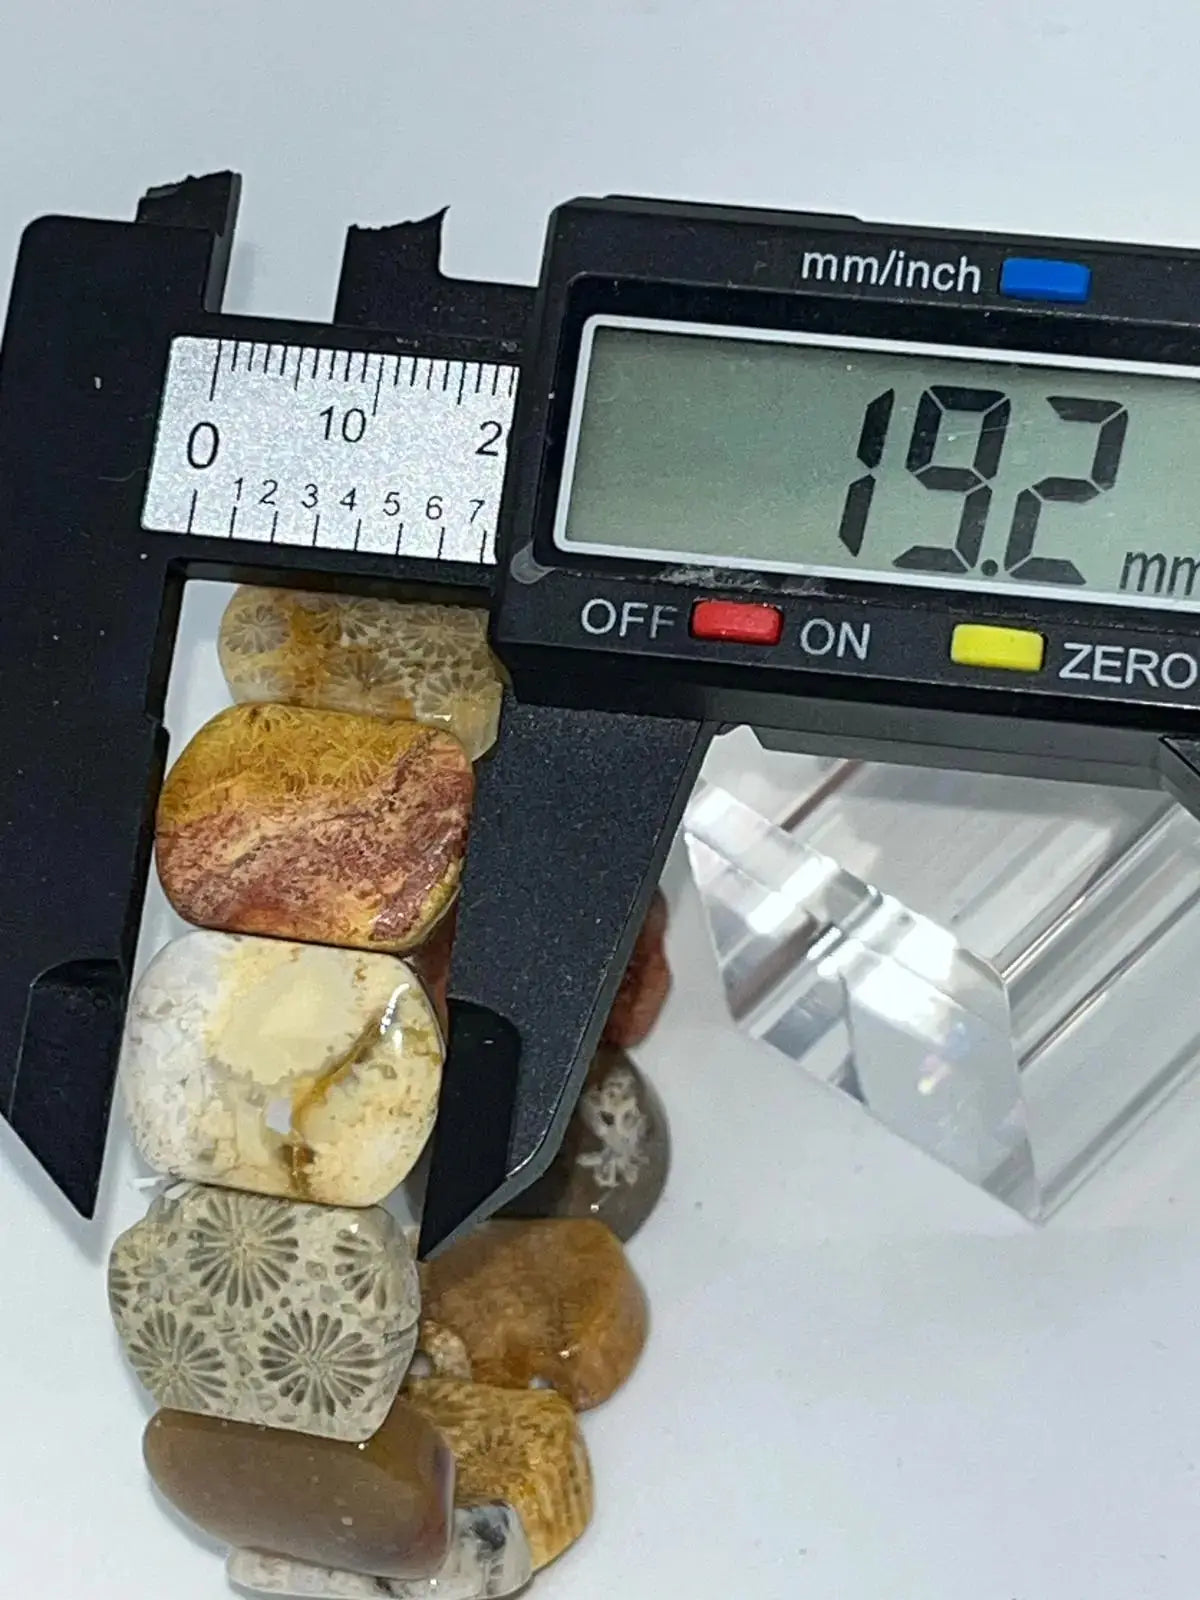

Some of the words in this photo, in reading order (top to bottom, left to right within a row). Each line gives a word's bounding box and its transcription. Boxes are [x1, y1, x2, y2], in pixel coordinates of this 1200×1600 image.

[801, 249, 982, 294] mm/inch
[187, 421, 220, 469] 0
[319, 405, 367, 443] 10
[234, 477, 244, 501] 1
[259, 479, 279, 506] 2
[301, 483, 319, 509] 3
[339, 487, 358, 511] 4
[382, 491, 401, 516] 5
[425, 495, 444, 520] 6
[469, 498, 486, 523] 7
[838, 384, 1129, 586] 19.2
[580, 598, 678, 640] OFF
[800, 618, 871, 661] ON
[1058, 642, 1198, 691] ZERO
